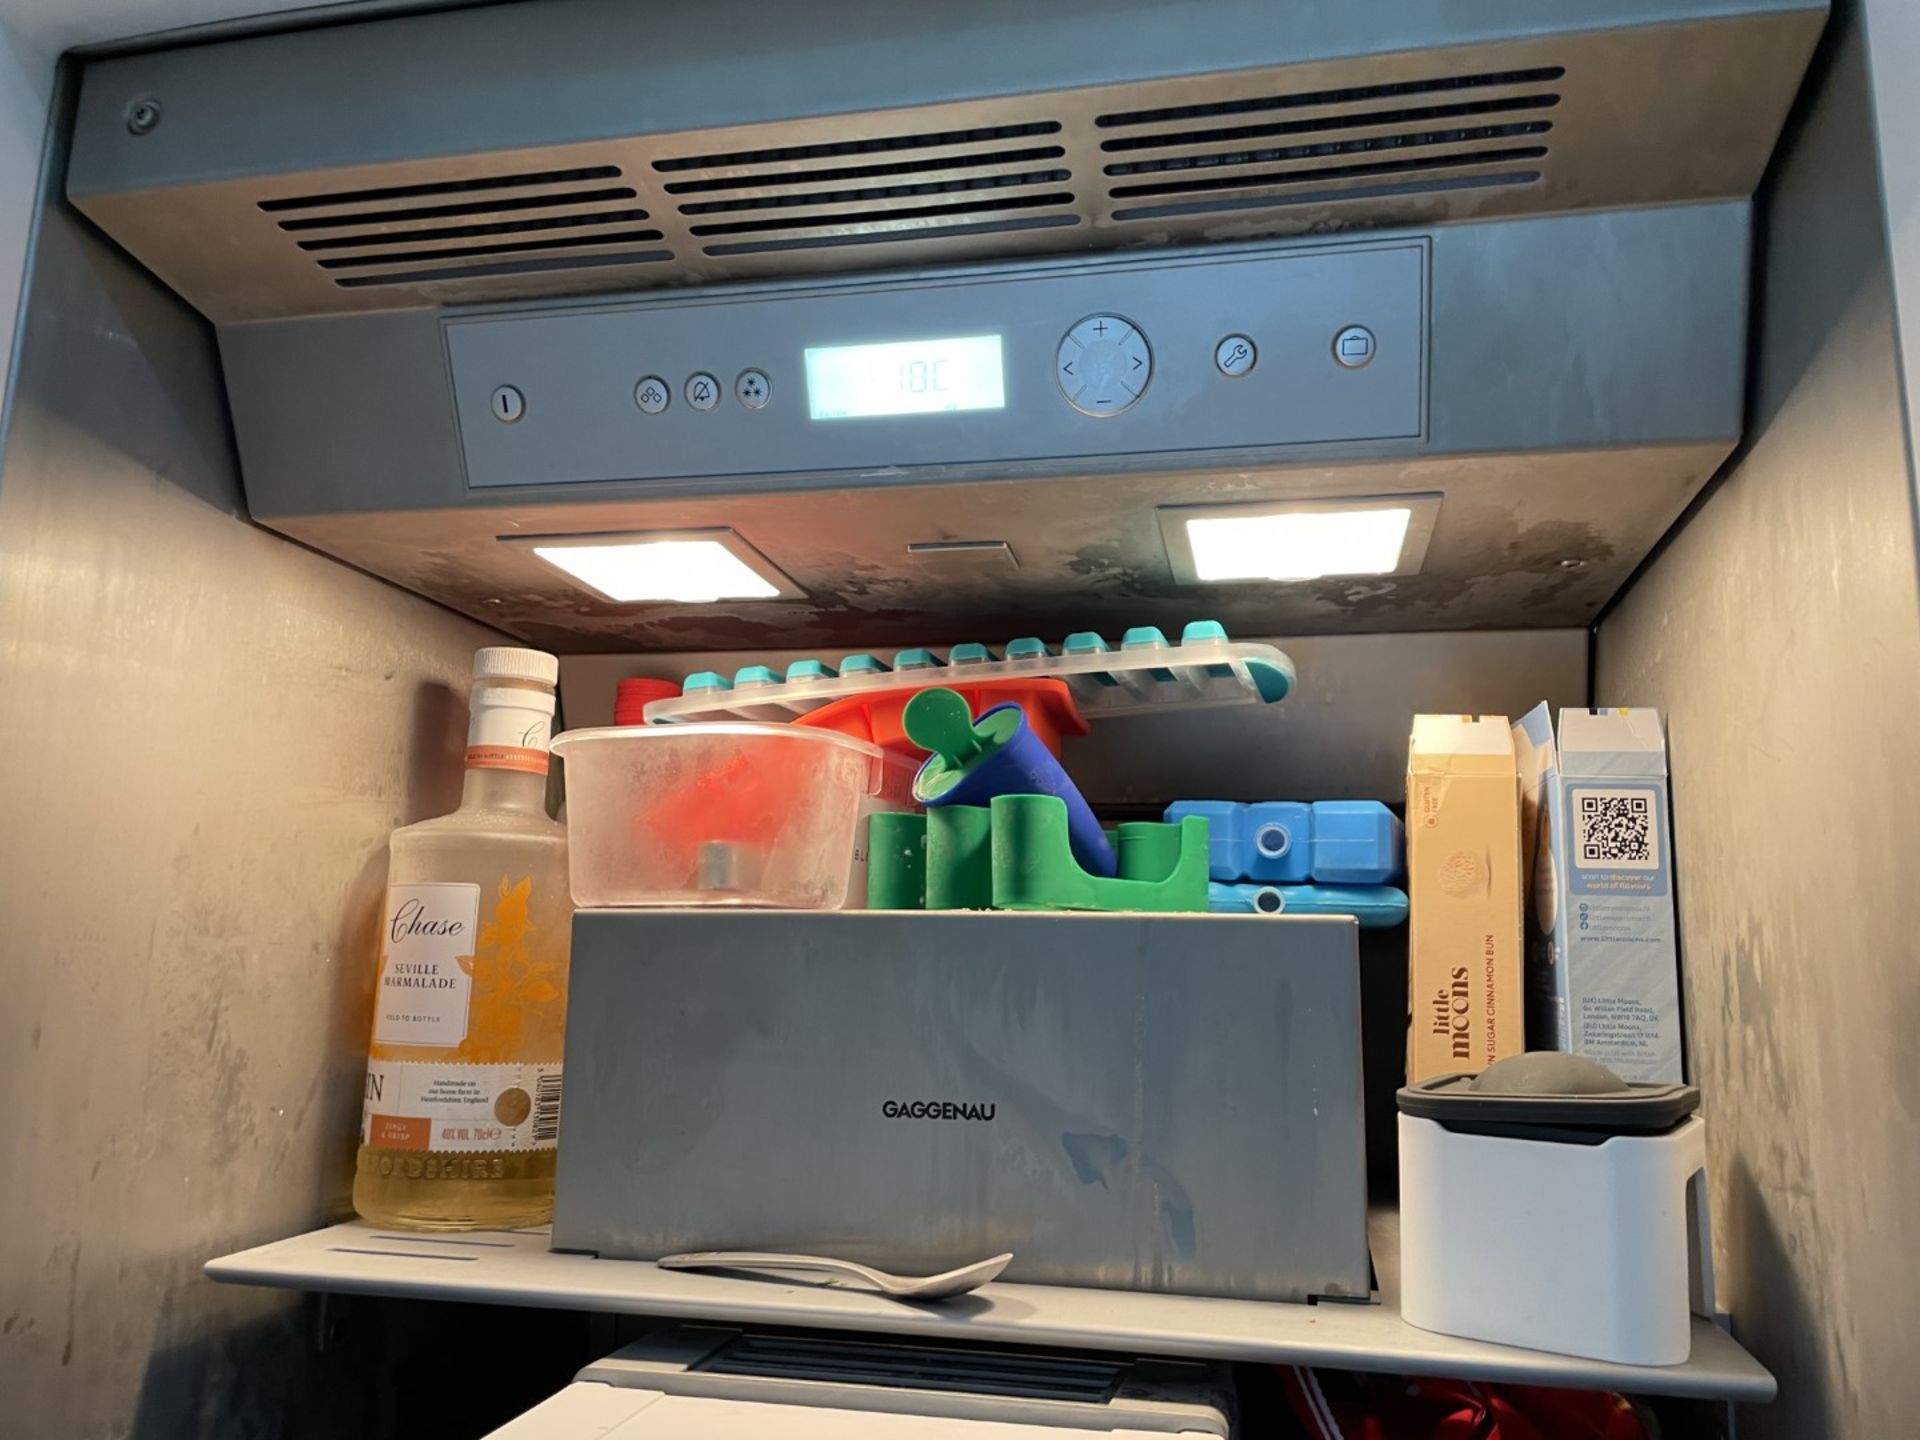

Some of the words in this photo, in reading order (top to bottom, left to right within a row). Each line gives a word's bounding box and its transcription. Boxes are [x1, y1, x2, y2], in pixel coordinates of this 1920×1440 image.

[1423, 786, 1431, 813] GLUTEN
[390, 898, 464, 944] Chase
[1485, 935, 1495, 956] BUN
[384, 976, 457, 989] MARMALADE
[395, 963, 439, 975] SEVILLE
[1486, 958, 1497, 1017] CINNAMON
[1433, 989, 1450, 1035] little
[1452, 967, 1470, 1060] moons
[1486, 1018, 1497, 1053] SUGAR
[882, 1100, 996, 1121] GAGGENAU
